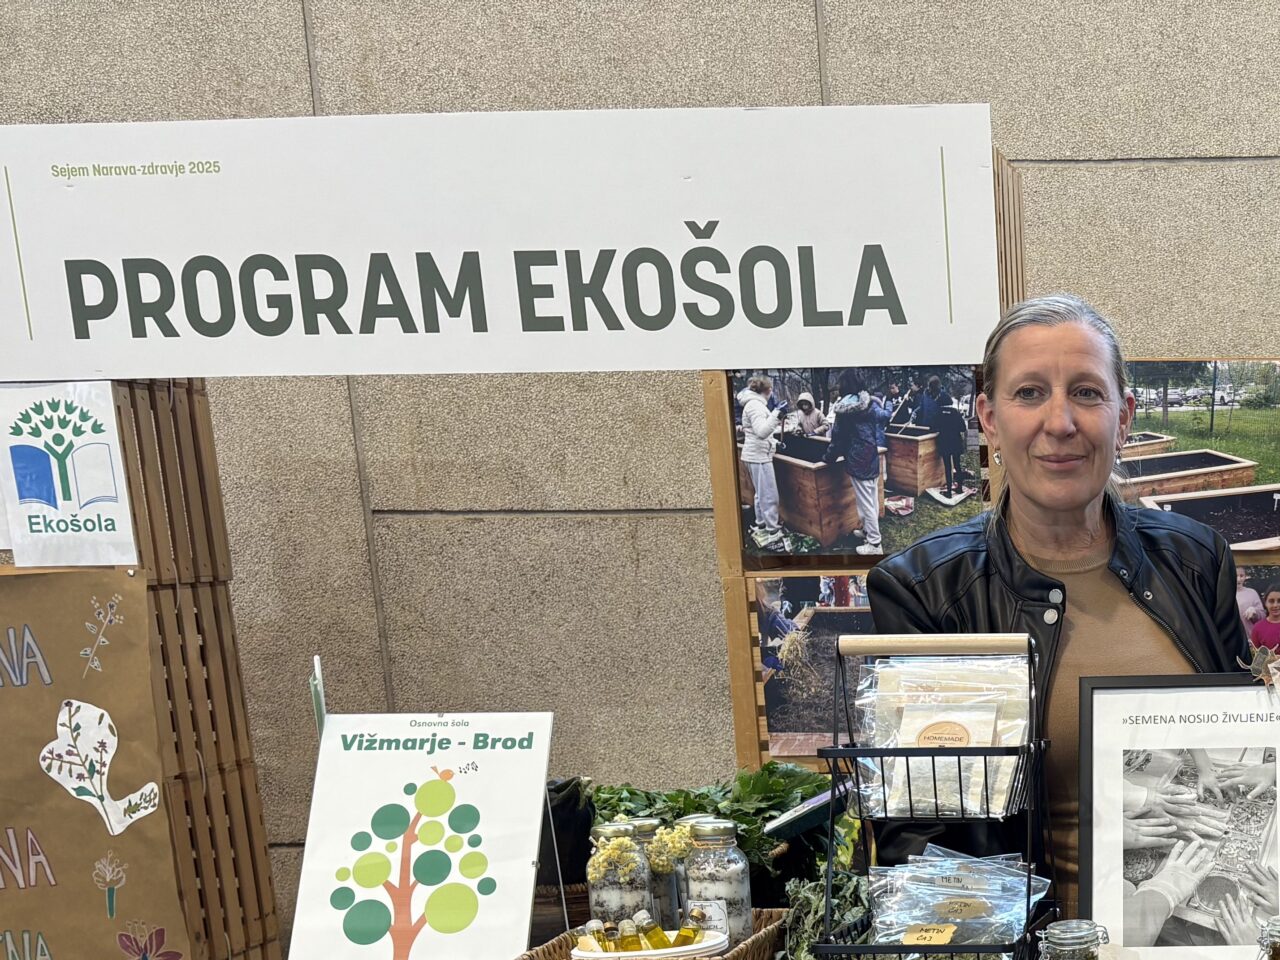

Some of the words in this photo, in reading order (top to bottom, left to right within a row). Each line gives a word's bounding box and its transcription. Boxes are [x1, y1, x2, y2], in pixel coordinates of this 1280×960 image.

[51, 163, 89, 180] Sejem
[92, 160, 186, 178] Narava-zdravje
[188, 160, 221, 175] 2025
[63, 250, 489, 340] PROGRAM
[513, 220, 909, 332] EKOŠOLA
[27, 513, 117, 535] Ekošola
[409, 719, 449, 728] Osnovna
[450, 719, 470, 727] šola
[1179, 713, 1219, 724] NOSIJO
[340, 732, 452, 755] Vižmarje
[472, 731, 534, 750] Brod
[923, 735, 964, 743] HOMEMADE
